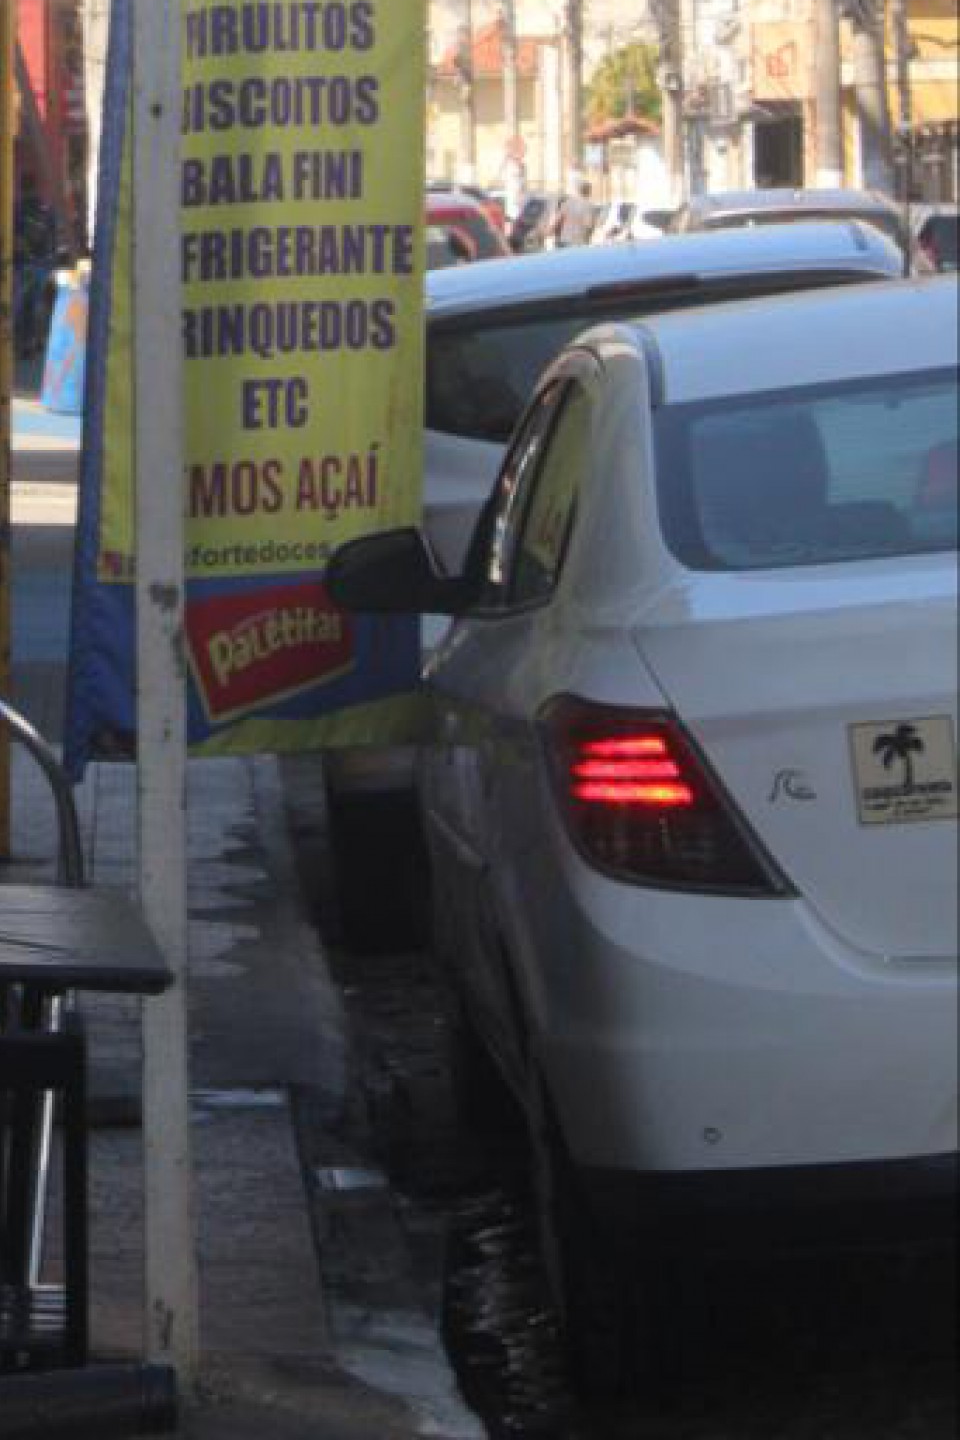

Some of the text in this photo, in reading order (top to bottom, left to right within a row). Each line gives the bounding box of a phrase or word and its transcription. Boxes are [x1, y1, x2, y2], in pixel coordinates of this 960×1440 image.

[181, 150, 362, 207] BALA FINI
[243, 376, 308, 430] ETC
[185, 442, 381, 520] MOS AÇAÍ
